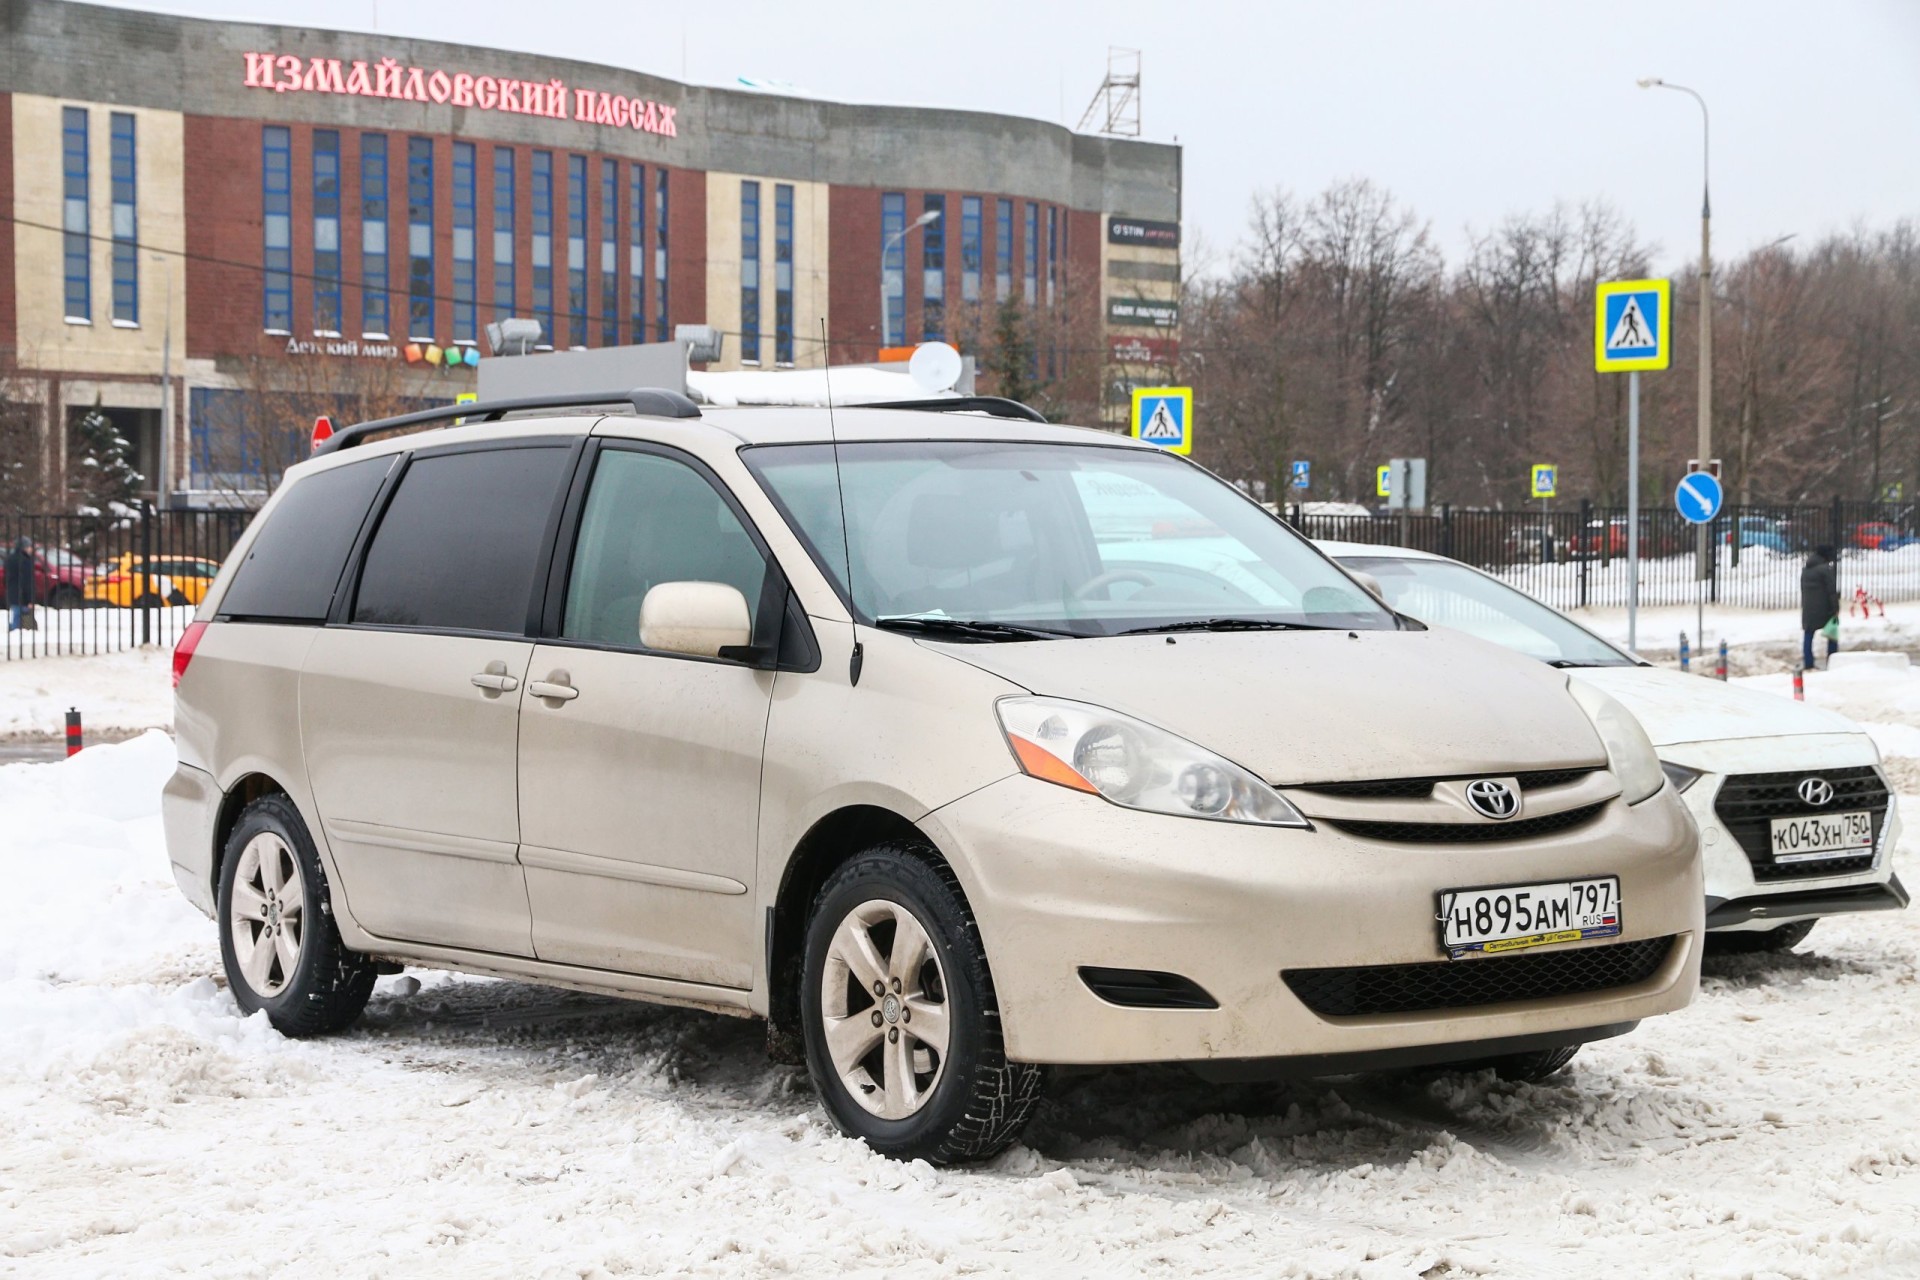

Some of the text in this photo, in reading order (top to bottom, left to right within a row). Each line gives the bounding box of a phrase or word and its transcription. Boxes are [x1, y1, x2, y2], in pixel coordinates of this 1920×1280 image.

[243, 51, 677, 138] ИЗМАЙЛОВСКИЙ ПАССАЖ
[285, 337, 398, 358] Детский мир
[1844, 814, 1867, 836] 750
[1454, 882, 1611, 938] Н895АМ 797
[1582, 914, 1602, 926] RUS
